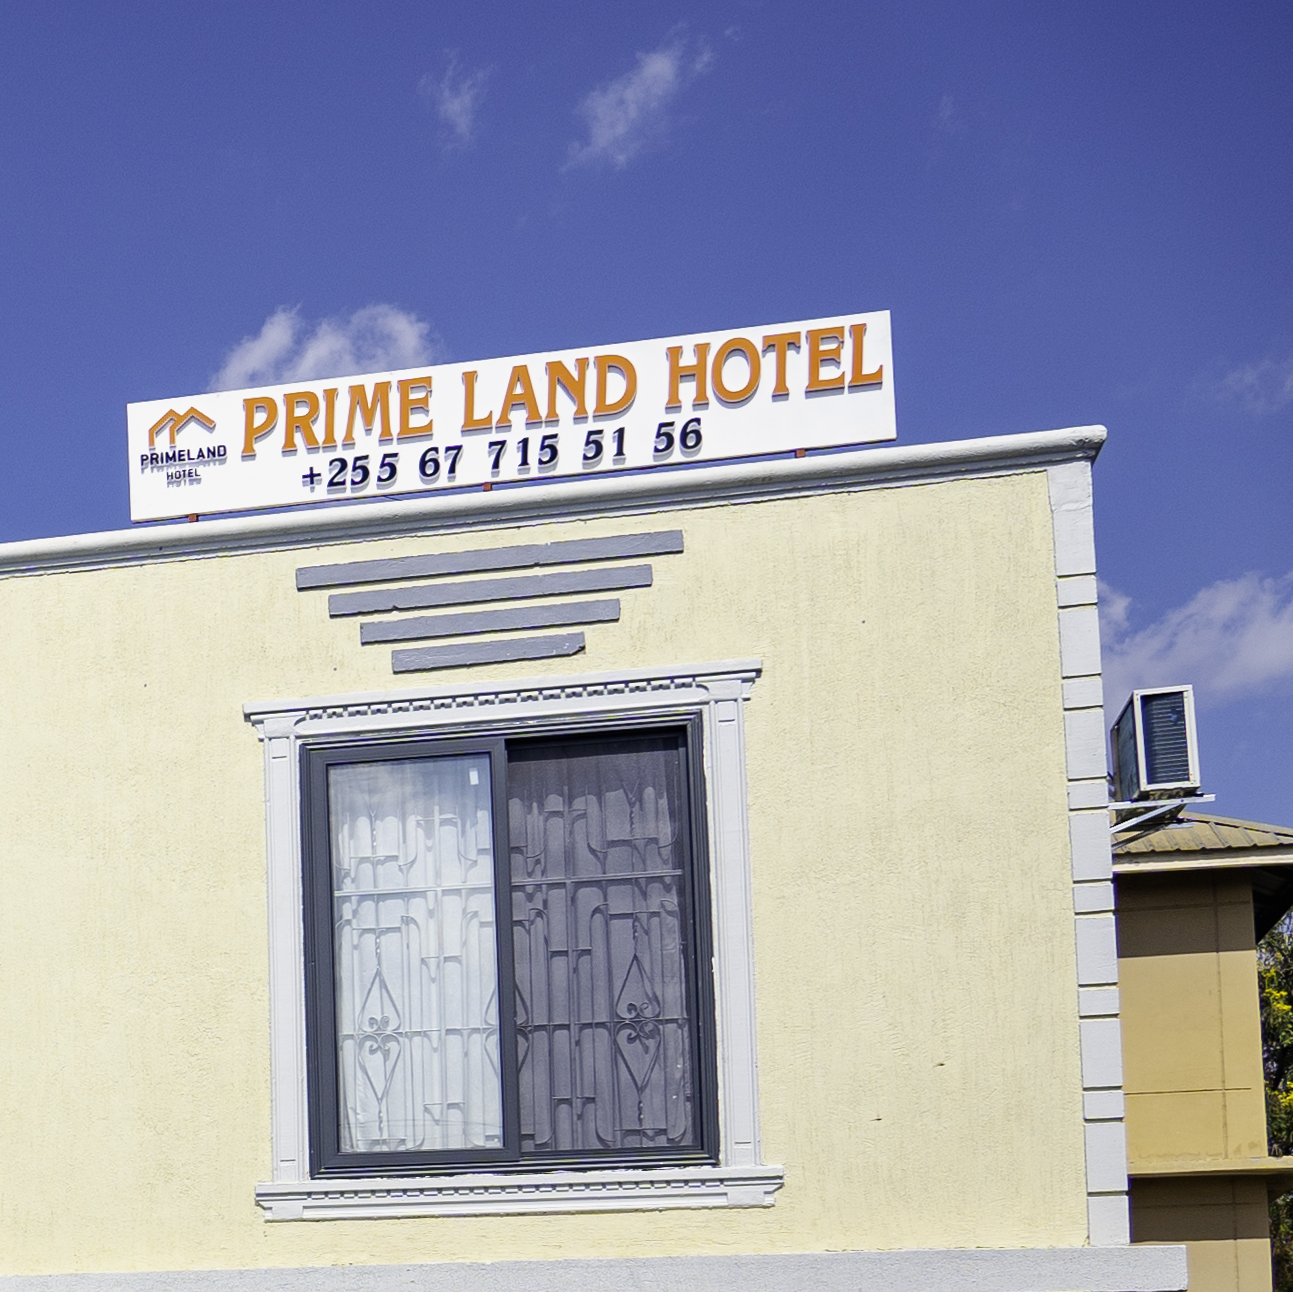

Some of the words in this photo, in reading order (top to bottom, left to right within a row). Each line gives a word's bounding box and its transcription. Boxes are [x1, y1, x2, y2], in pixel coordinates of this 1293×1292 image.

[241, 376, 433, 455] PRIME
[461, 355, 637, 430] LAND
[665, 323, 883, 406] HOTEL
[140, 445, 227, 466] PRIMELAND
[166, 468, 201, 480] HOTEL
[302, 453, 399, 488] +255
[419, 445, 463, 478] 67
[488, 433, 559, 471] 715
[582, 427, 625, 462] 51
[653, 418, 703, 453] 56
